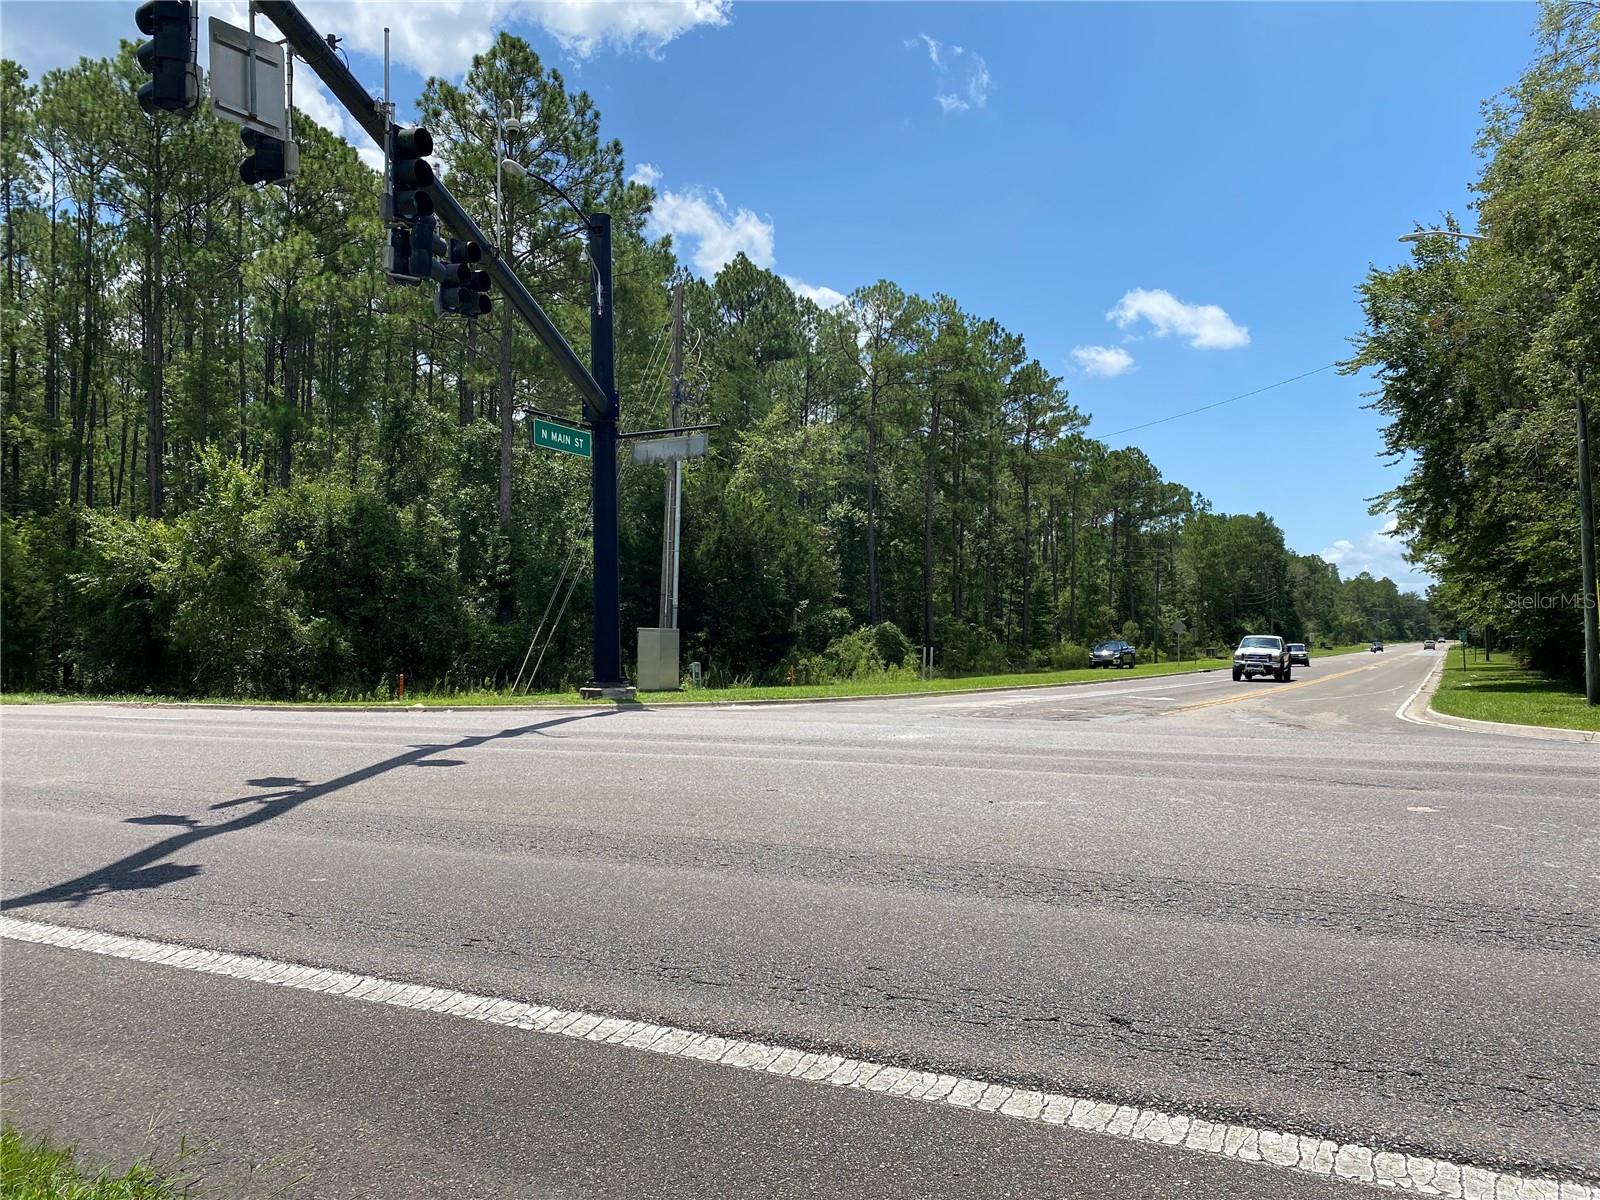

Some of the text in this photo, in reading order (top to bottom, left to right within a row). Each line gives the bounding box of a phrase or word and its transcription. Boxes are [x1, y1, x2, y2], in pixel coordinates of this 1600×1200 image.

[541, 428, 584, 449] N MAIN ST
